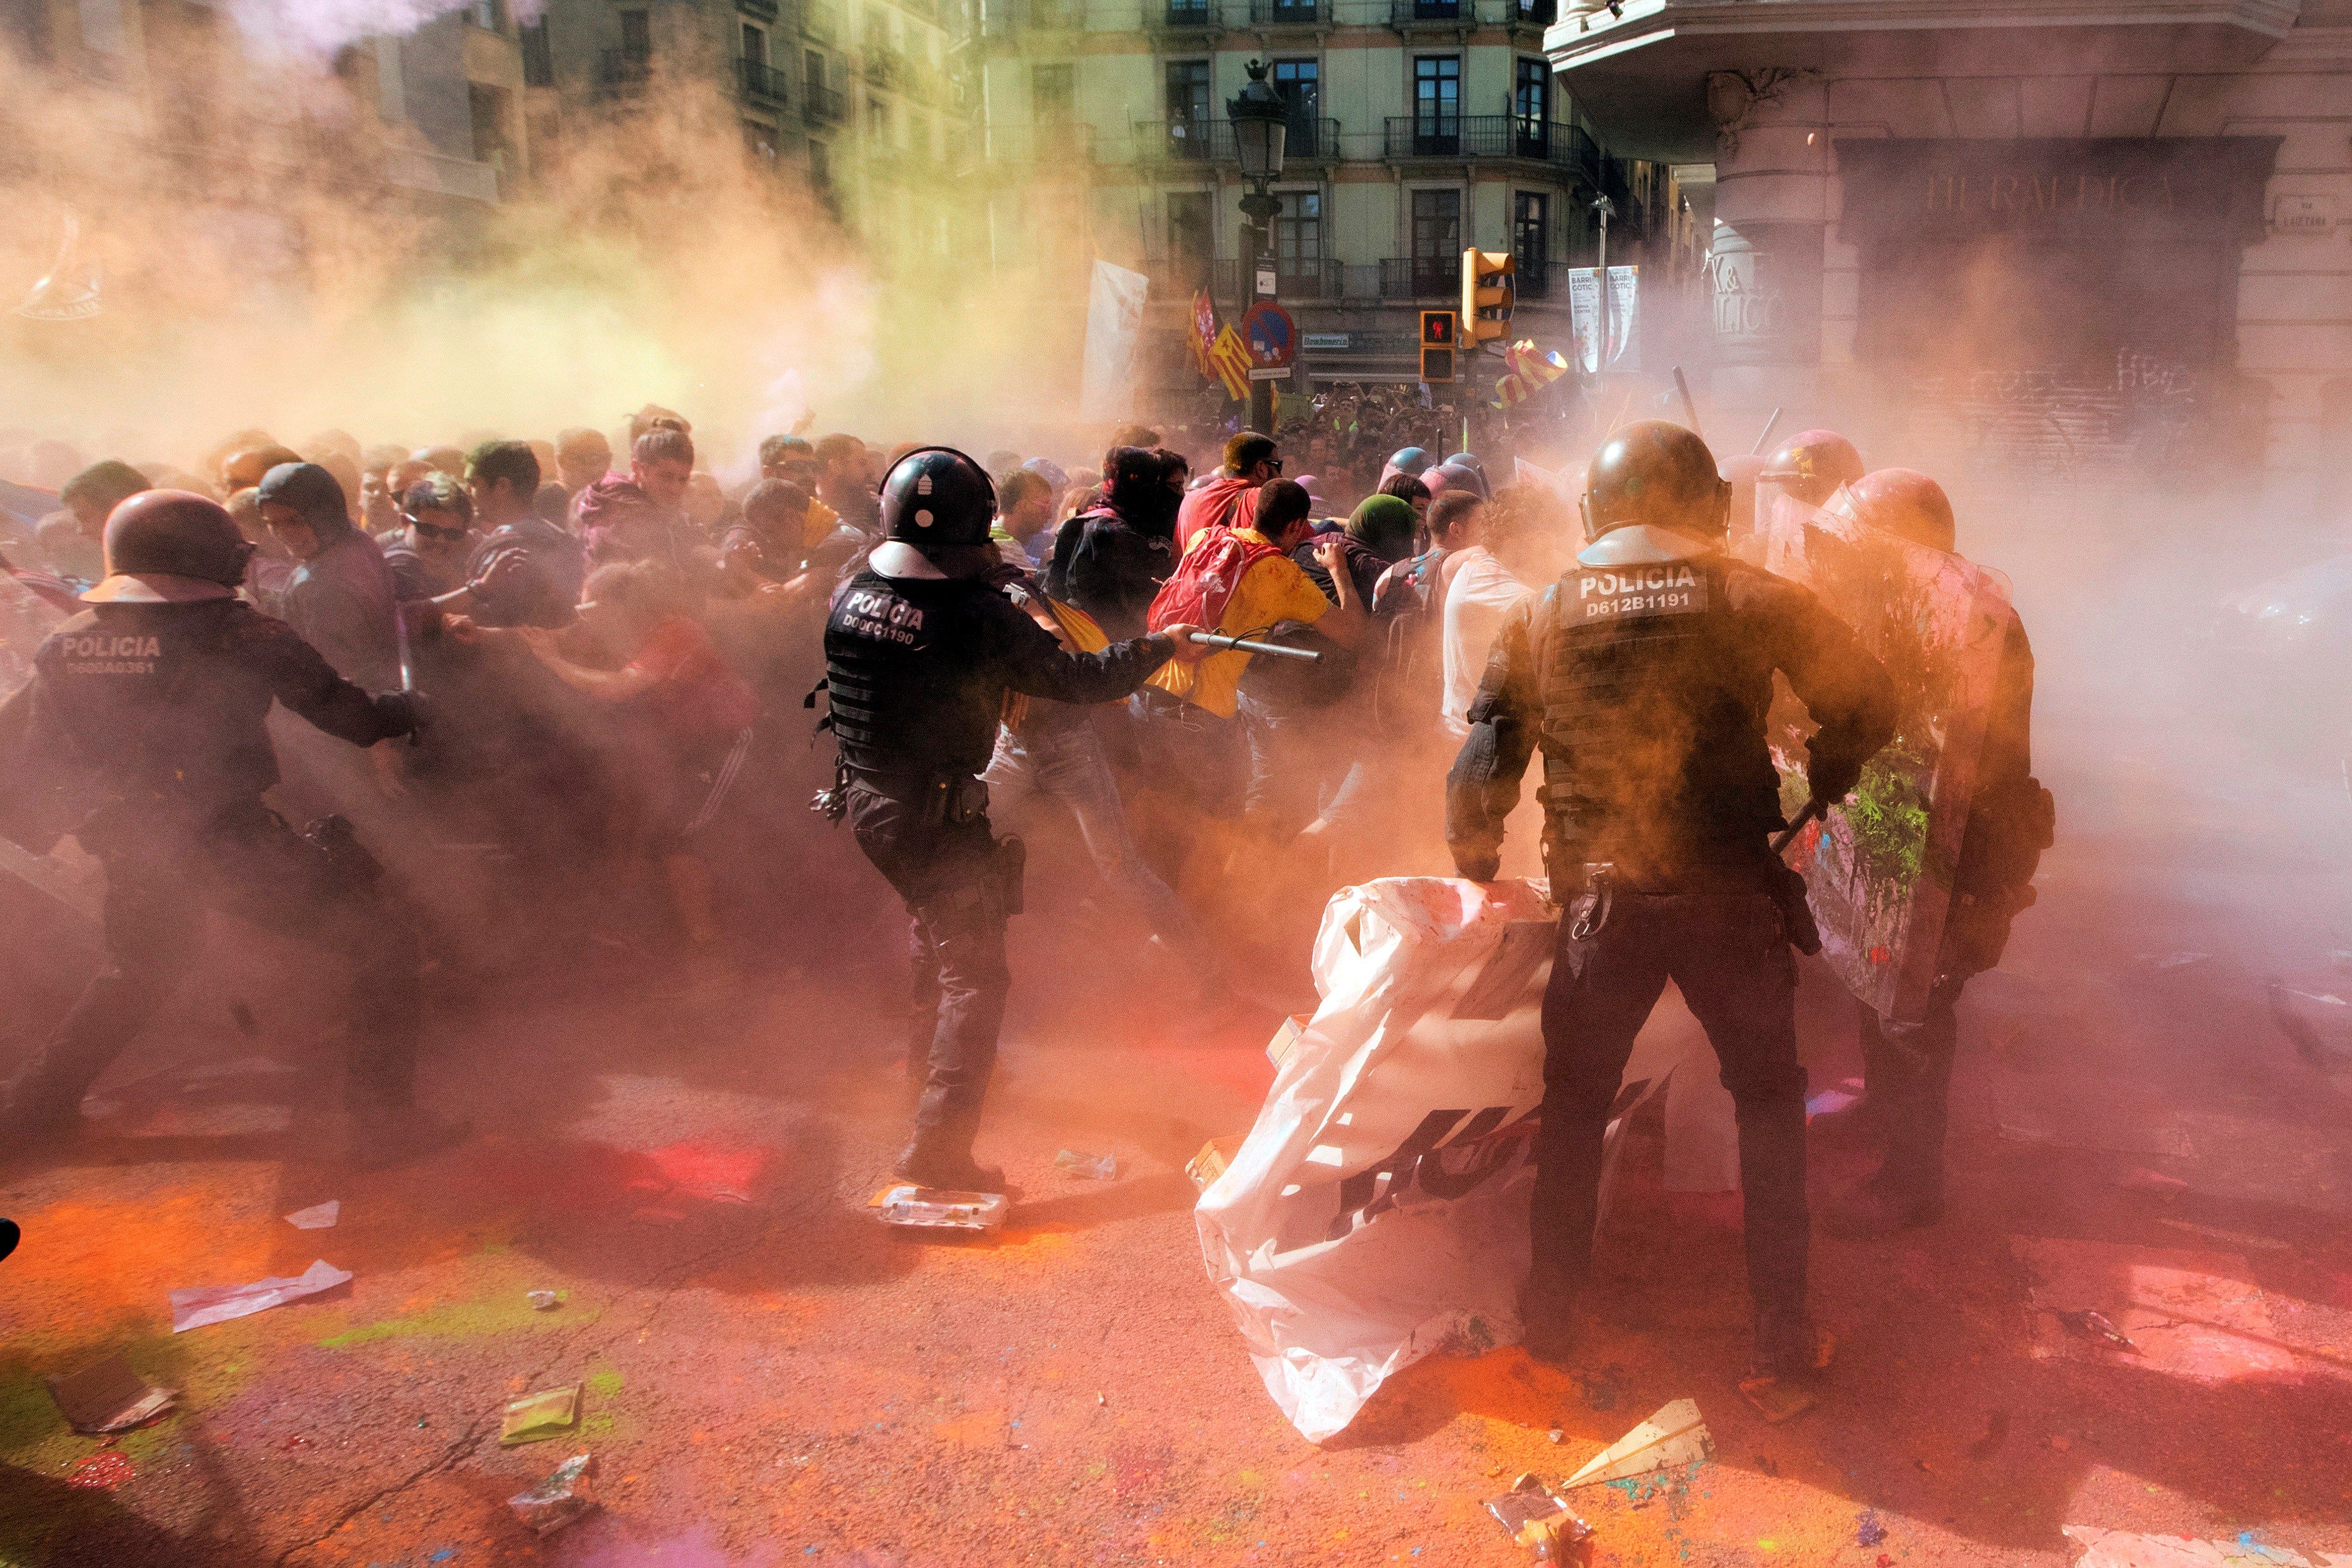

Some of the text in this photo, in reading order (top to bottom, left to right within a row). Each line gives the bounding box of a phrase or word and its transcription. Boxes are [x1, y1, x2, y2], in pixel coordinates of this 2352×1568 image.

[1726, 265, 1739, 293] &
[1579, 565, 1696, 599] POLICIA
[846, 592, 924, 631] POLICIA
[1586, 592, 1689, 617] D612B1191
[62, 636, 161, 658] POLICIA
